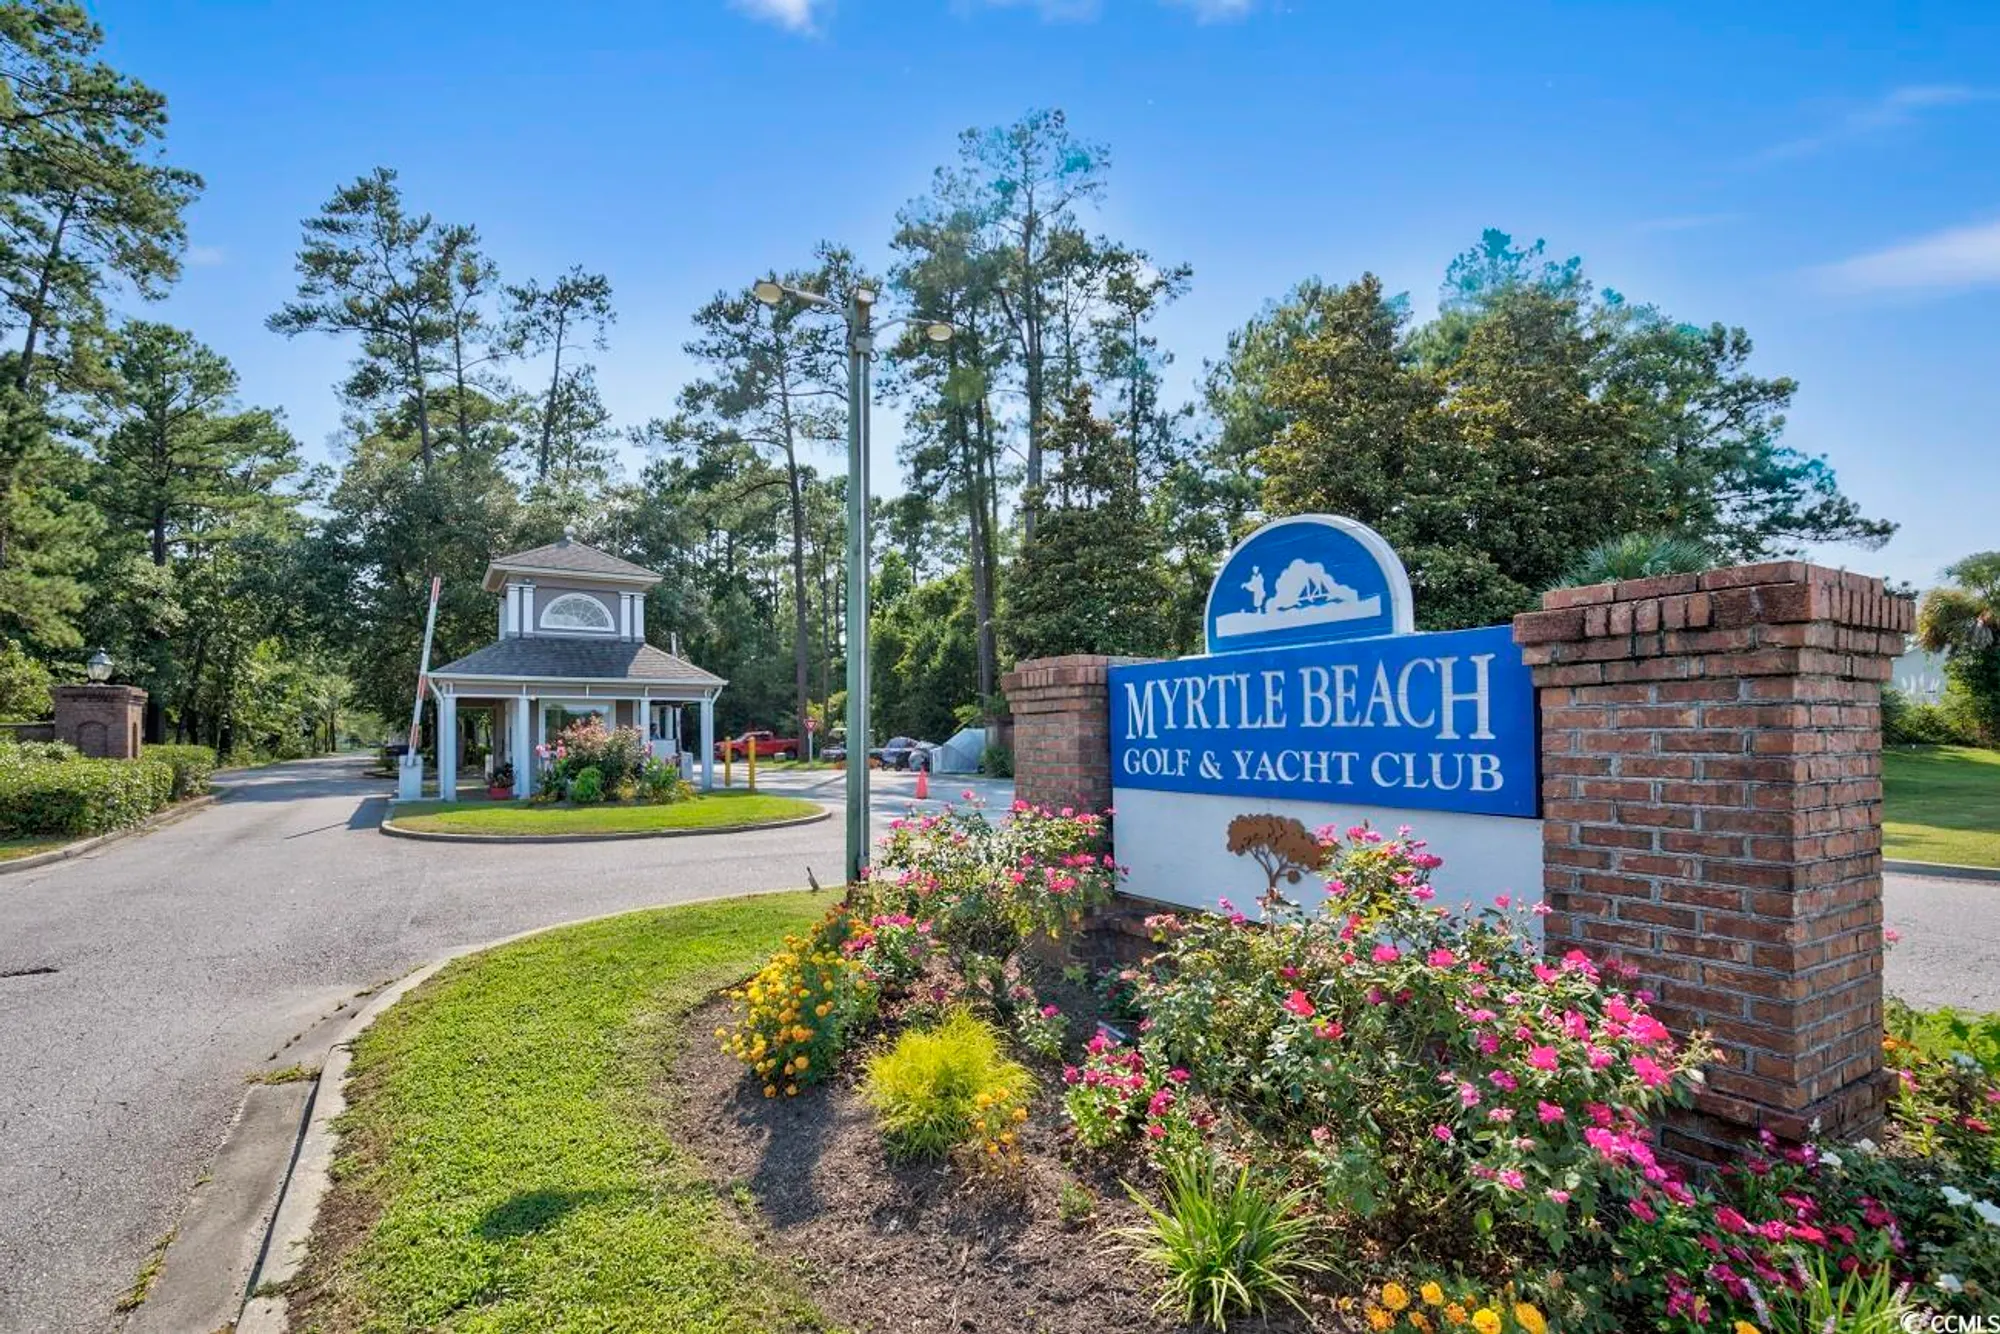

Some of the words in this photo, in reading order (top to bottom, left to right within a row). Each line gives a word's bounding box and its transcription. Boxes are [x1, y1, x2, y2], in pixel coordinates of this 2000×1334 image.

[1124, 670, 1287, 740] MYRTLE
[1299, 653, 1496, 740] BEACH
[1123, 748, 1191, 777] GOLF
[1199, 750, 1223, 780] &
[1232, 750, 1359, 785] YACHT
[1371, 752, 1504, 791] CLUB
